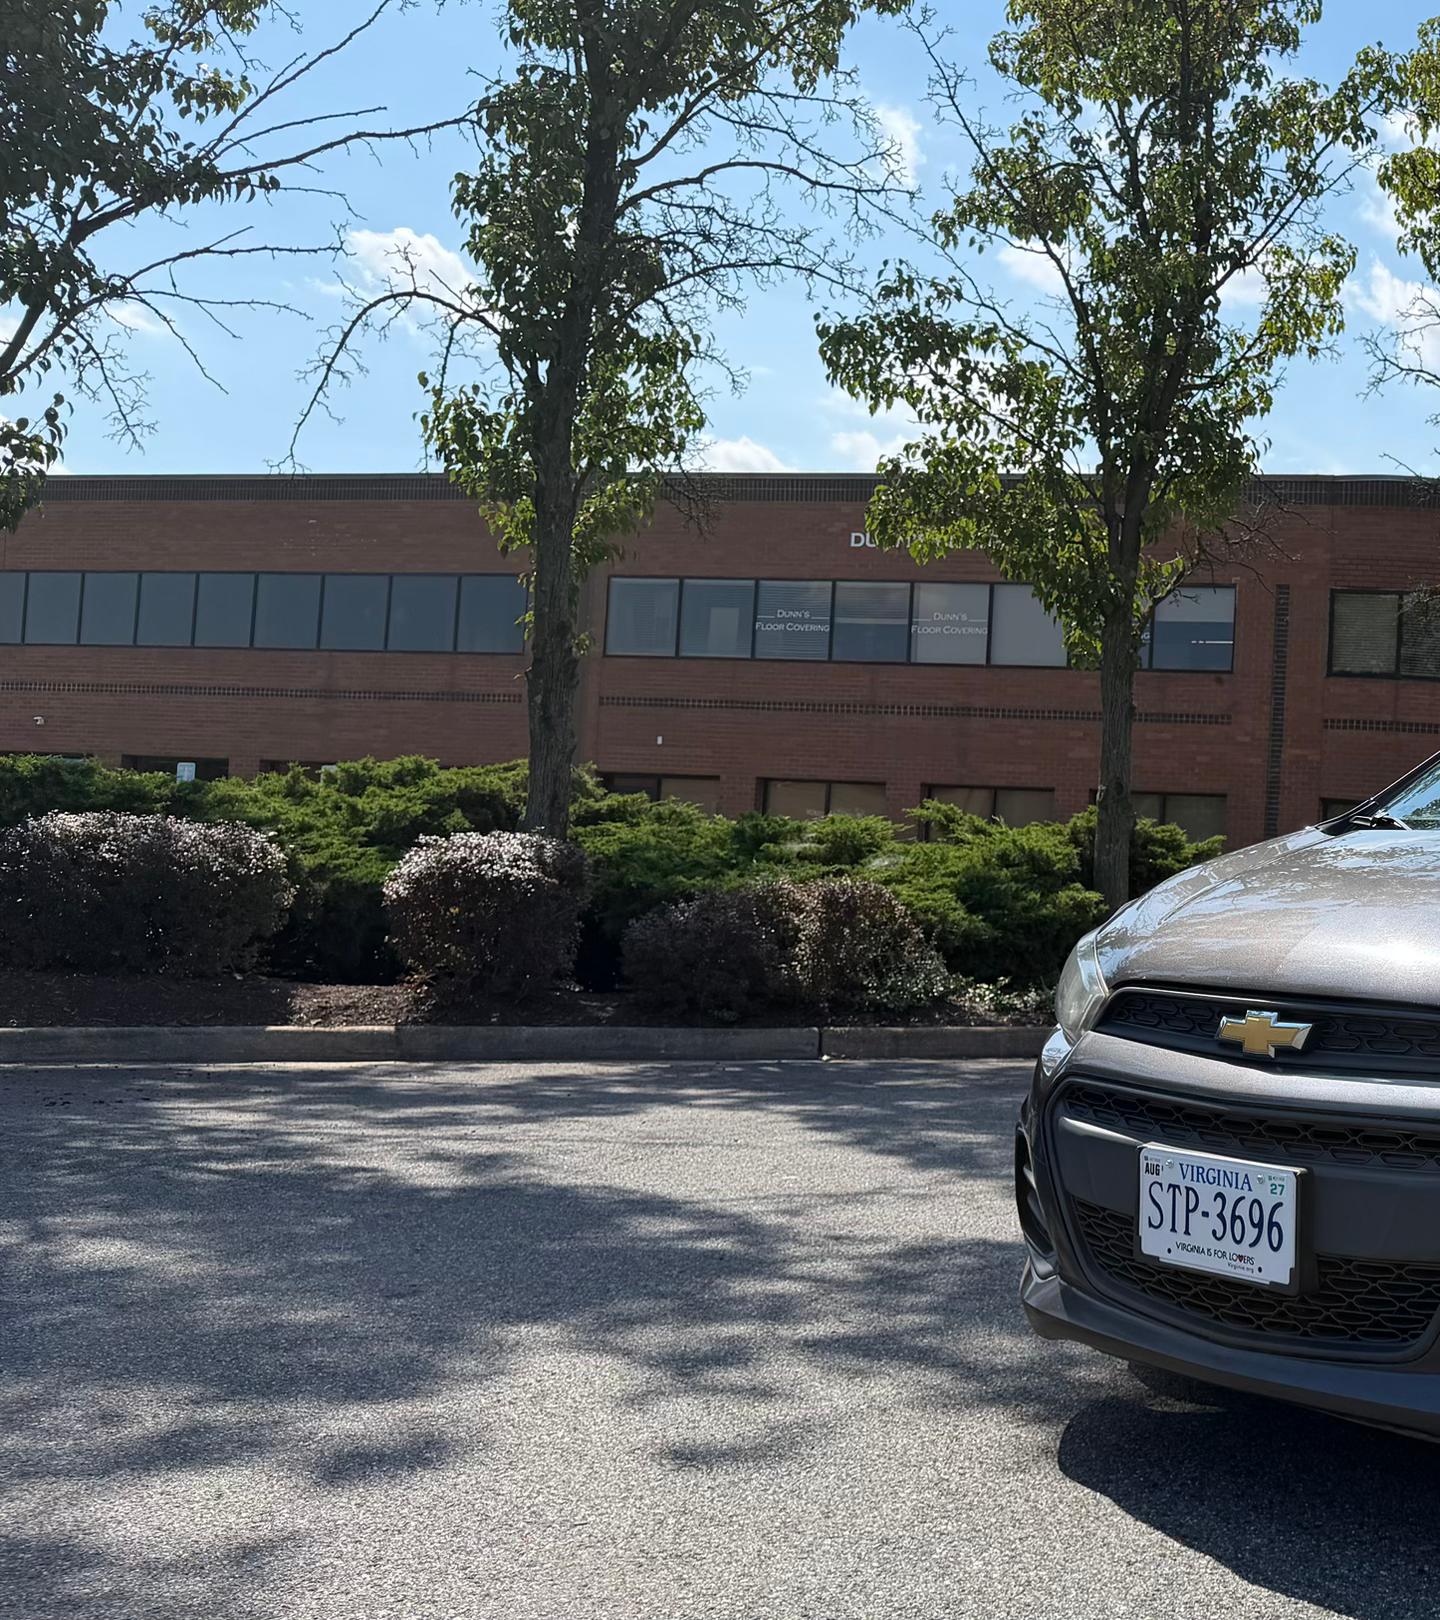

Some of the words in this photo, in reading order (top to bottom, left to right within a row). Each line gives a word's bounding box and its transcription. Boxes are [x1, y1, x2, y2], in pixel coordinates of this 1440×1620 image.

[1145, 1162, 1160, 1176] AUG
[1179, 1163, 1252, 1192] VIRGINIA
[1270, 1183, 1285, 1196] 27
[1148, 1181, 1284, 1252] STP-3696
[1176, 1241, 1206, 1255] VIRGINIA
[1207, 1248, 1212, 1257] IS
[1213, 1249, 1228, 1260] FOR
